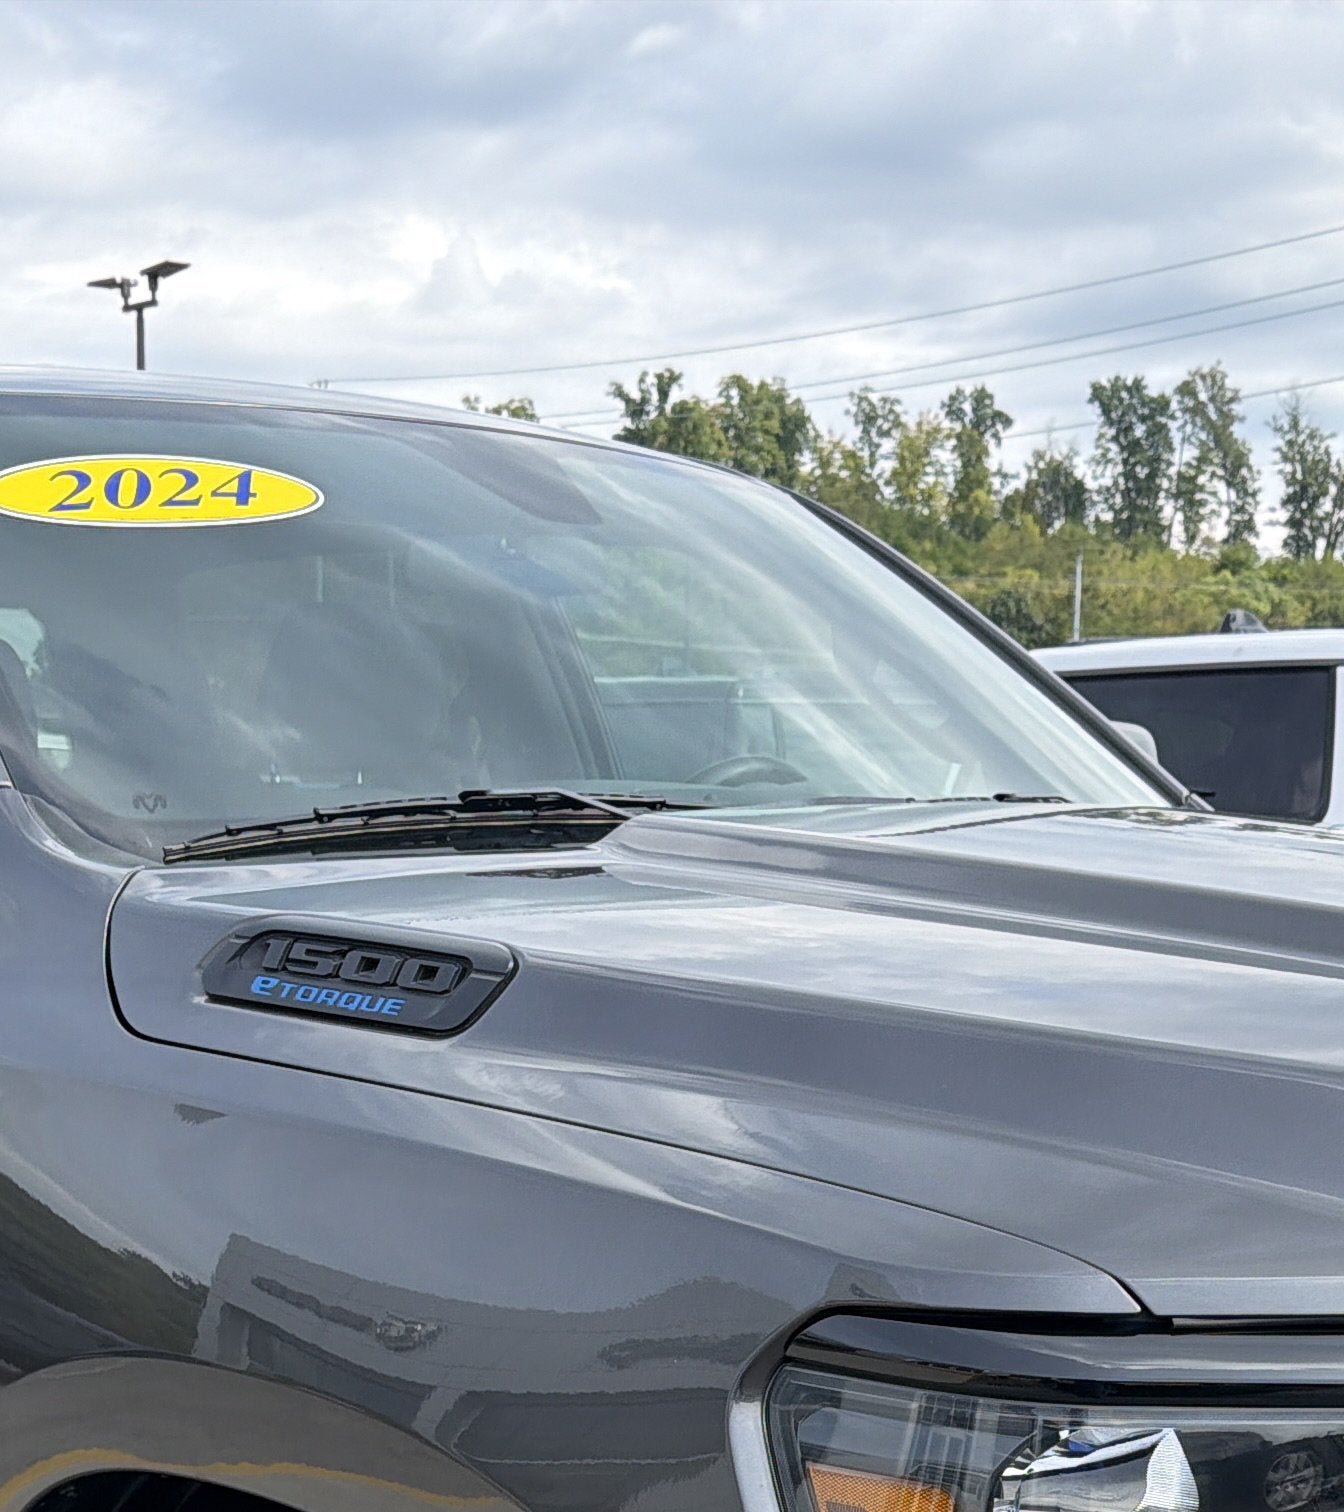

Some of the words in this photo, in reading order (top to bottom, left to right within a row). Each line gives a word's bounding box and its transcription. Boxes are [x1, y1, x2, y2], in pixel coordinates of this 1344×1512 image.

[48, 467, 258, 513] 2024
[261, 937, 463, 995] 1500
[251, 975, 406, 1017] eTORQUE
